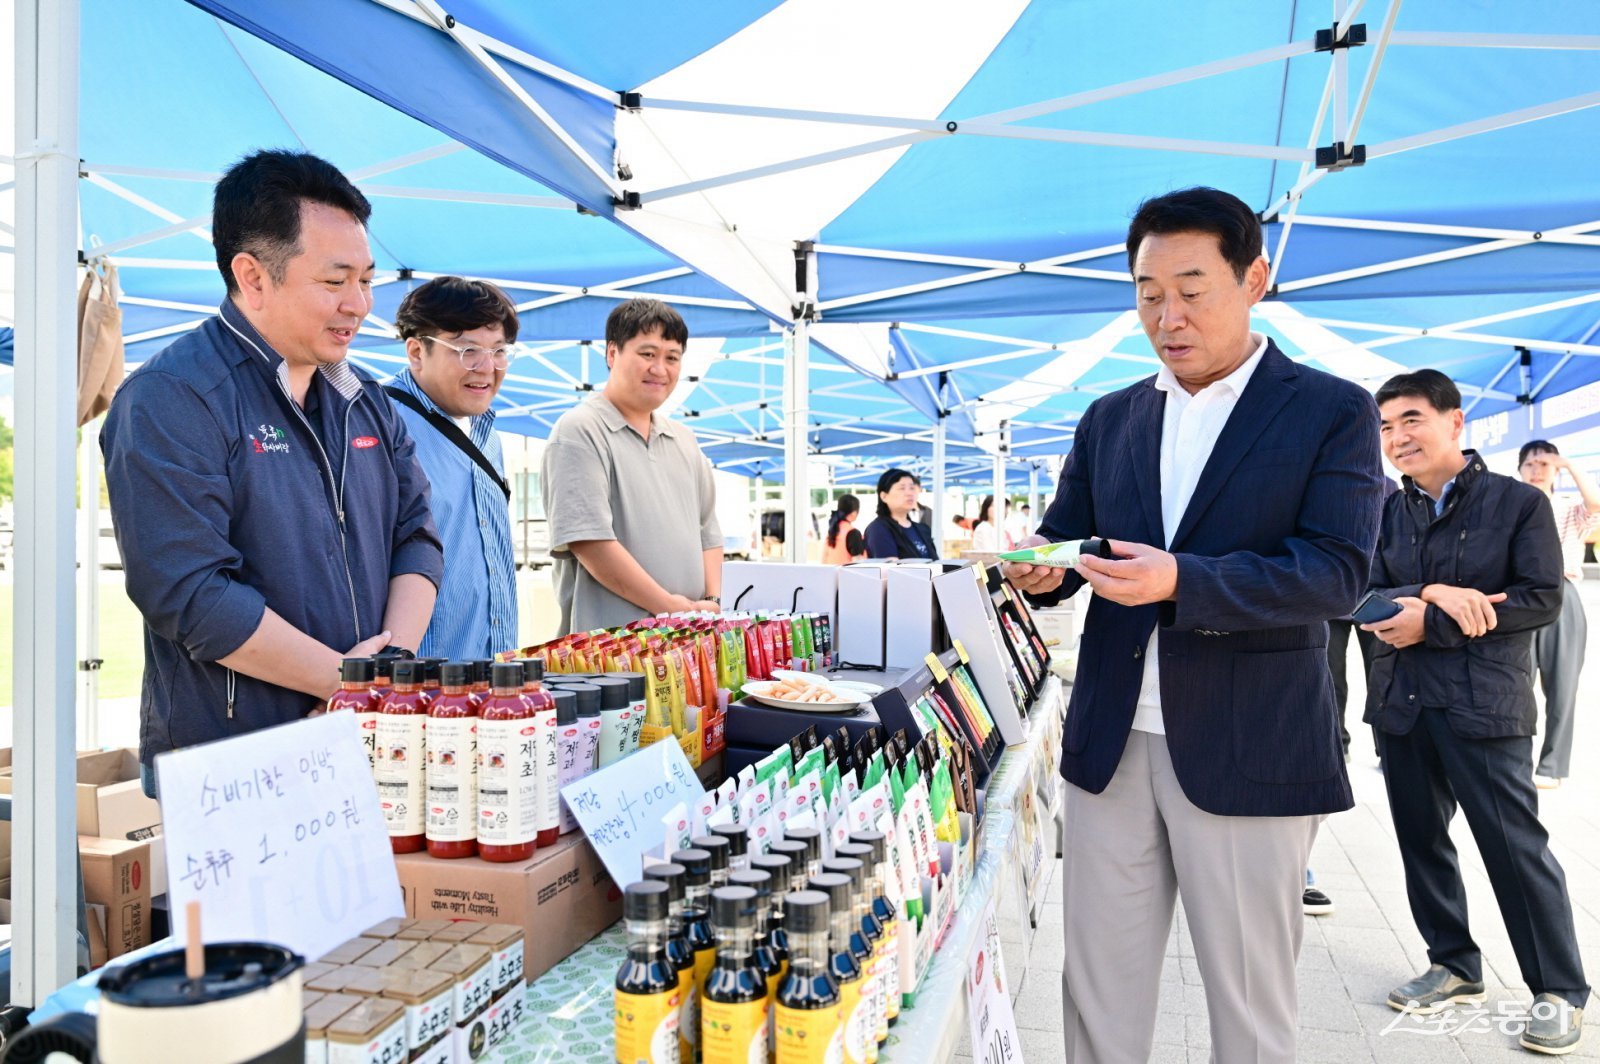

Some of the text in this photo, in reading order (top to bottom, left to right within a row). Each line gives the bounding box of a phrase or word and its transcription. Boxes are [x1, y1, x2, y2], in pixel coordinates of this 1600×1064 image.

[200, 747, 336, 817] 소비기한 임박
[520, 760, 537, 778] 초
[573, 787, 601, 813] 저당
[590, 815, 631, 847] 계란간장
[179, 849, 235, 891] 순후추
[431, 900, 498, 917] Healthy Life with
[433, 888, 496, 904] Tasty Moments
[498, 954, 522, 984] 순후추
[463, 978, 491, 1015] 순후추
[418, 1006, 449, 1041] 순후추
[488, 998, 523, 1047] 순후추
